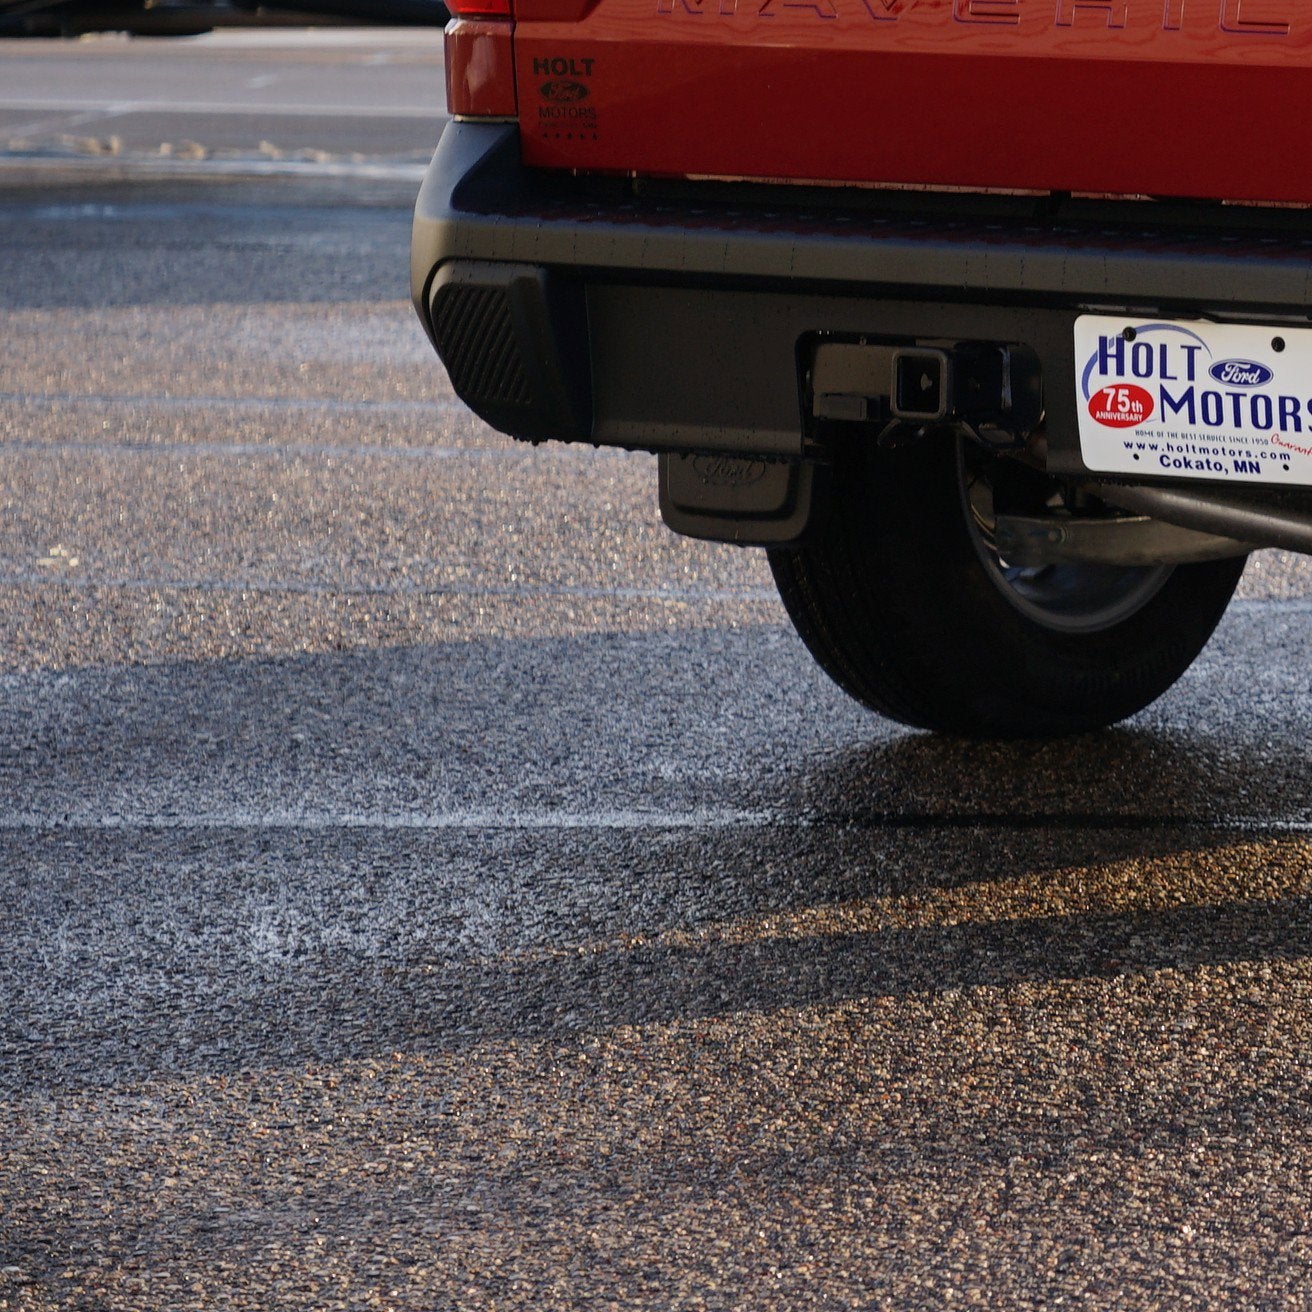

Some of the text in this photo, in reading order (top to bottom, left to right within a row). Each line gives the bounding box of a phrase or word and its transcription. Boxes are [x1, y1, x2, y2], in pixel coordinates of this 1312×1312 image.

[533, 57, 595, 76] HOLT
[538, 106, 598, 120] MOTORS
[1098, 335, 1202, 381] HOLT
[1102, 388, 1143, 413] 75th
[1095, 410, 1143, 422] ANNIVERSARY
[1135, 429, 1269, 445] HOME OF THE BEST SERVICE SINCE 1950
[1123, 440, 1291, 461] www.holtmotors.com
[1159, 454, 1261, 475] Cokato, MN
